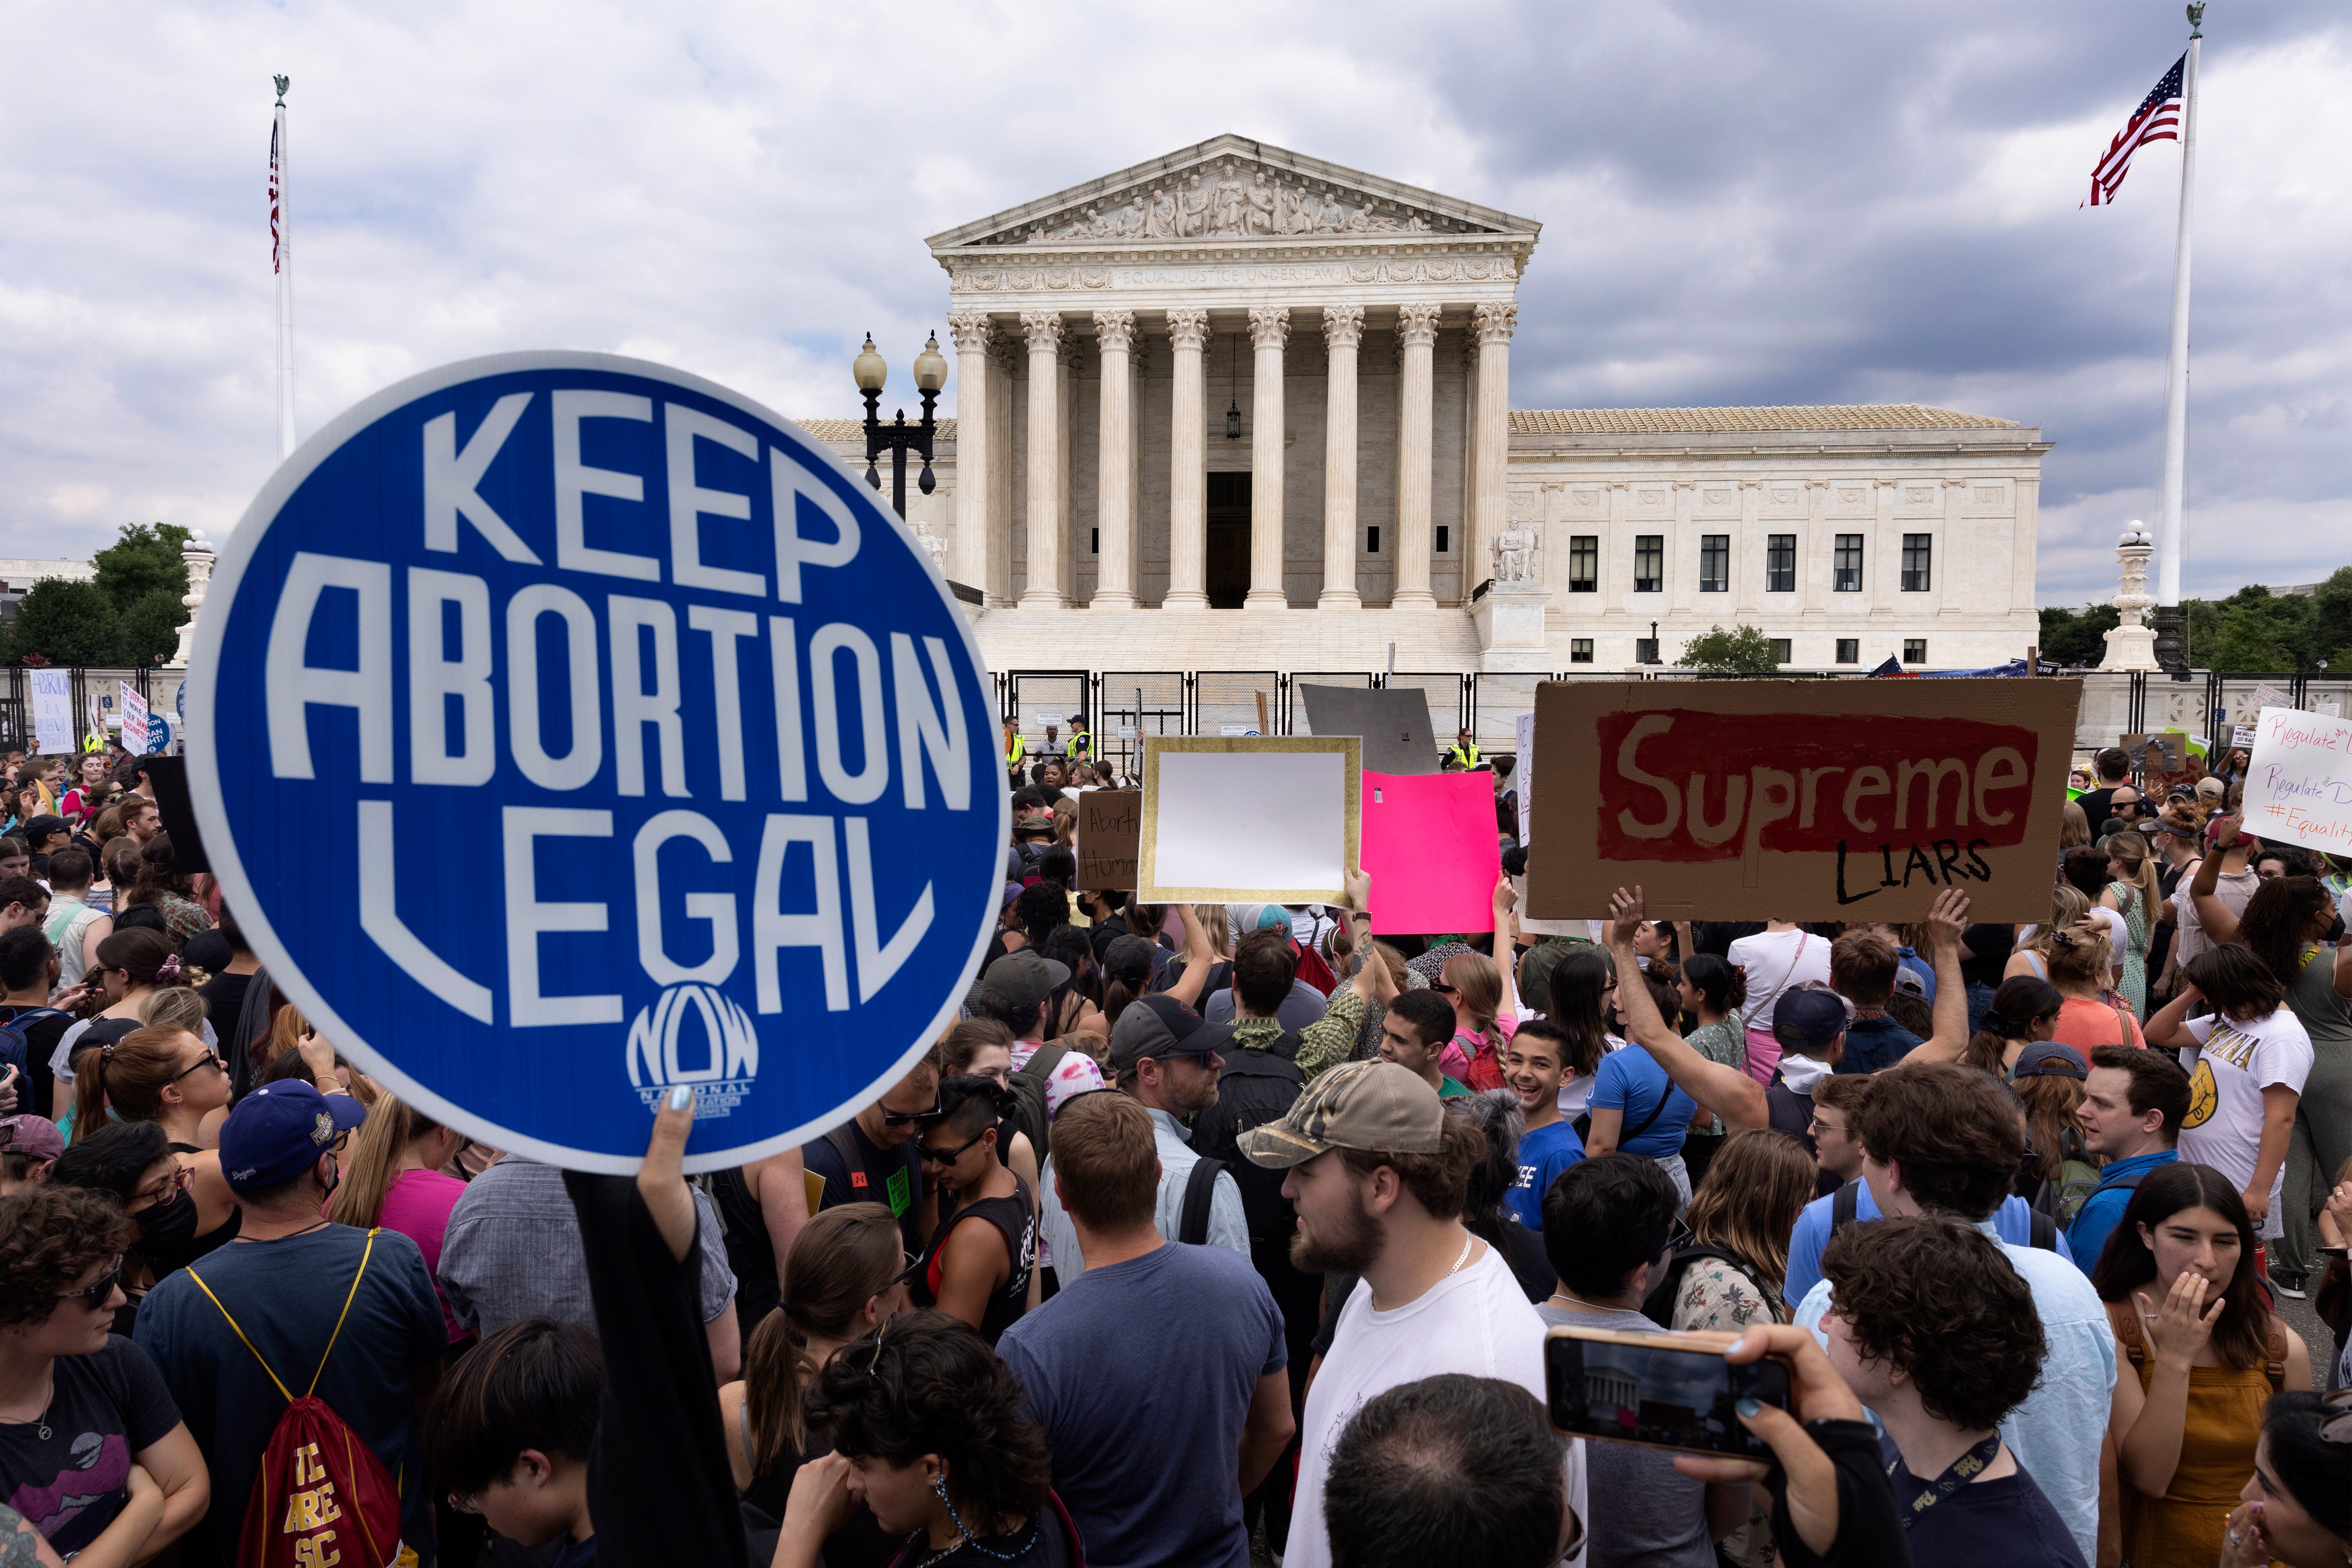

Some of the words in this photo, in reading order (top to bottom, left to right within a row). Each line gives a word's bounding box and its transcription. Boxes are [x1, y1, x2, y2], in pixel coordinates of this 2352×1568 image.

[1123, 272, 1175, 284] EQUAL
[1177, 269, 1239, 283] JUSTICE
[1247, 269, 1299, 281] UNDER
[1304, 267, 1336, 279] LAW
[423, 390, 862, 605] KEEP
[33, 673, 70, 696] ABORTION
[265, 552, 971, 810] ABORTION
[44, 699, 52, 715] is
[54, 704, 60, 715] a
[122, 683, 129, 693] MY
[129, 689, 147, 709] UTERUS
[129, 700, 142, 717] NONE
[36, 717, 65, 732] HUMAN
[123, 706, 136, 724] YOUR
[147, 719, 161, 727] ION
[39, 732, 67, 748] RIGHT
[123, 719, 147, 744] BUSINESS!
[2267, 714, 2336, 750] Regulate
[1520, 752, 1533, 780] GO
[2264, 763, 2323, 801] Regulate
[1616, 714, 2029, 888] Supreme
[1090, 806, 1139, 833] Aborti
[1083, 849, 1138, 880] Huma
[1836, 837, 1992, 906] LIARS
[357, 799, 936, 1027] LEGAL
[626, 984, 759, 1087] NOW
[640, 1083, 750, 1101] NAONAL
[232, 1167, 256, 1180] Dodgers
[893, 1194, 897, 1204] IS
[283, 1481, 342, 1534] ARE
[295, 1530, 341, 1568] SC
